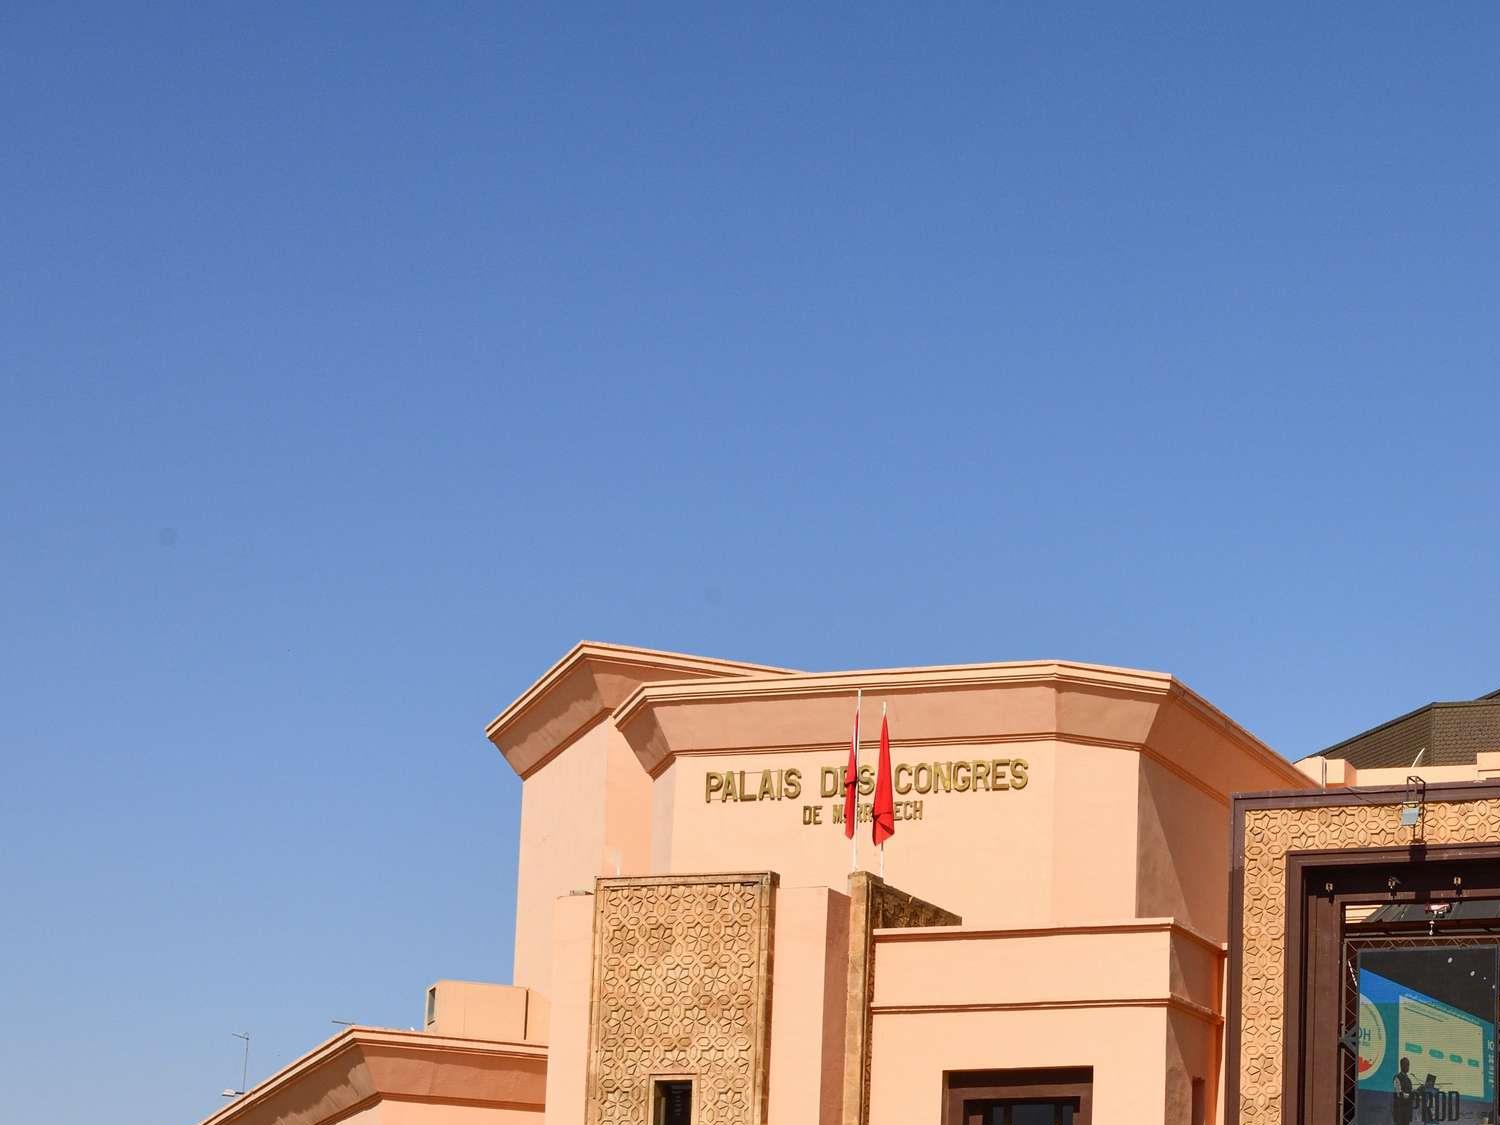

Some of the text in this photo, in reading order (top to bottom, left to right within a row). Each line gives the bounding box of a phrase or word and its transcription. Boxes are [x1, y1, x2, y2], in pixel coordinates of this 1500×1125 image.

[704, 767, 802, 803] PALAIS
[894, 757, 1029, 795] CONGRES
[802, 800, 923, 825] DE MRRECH
